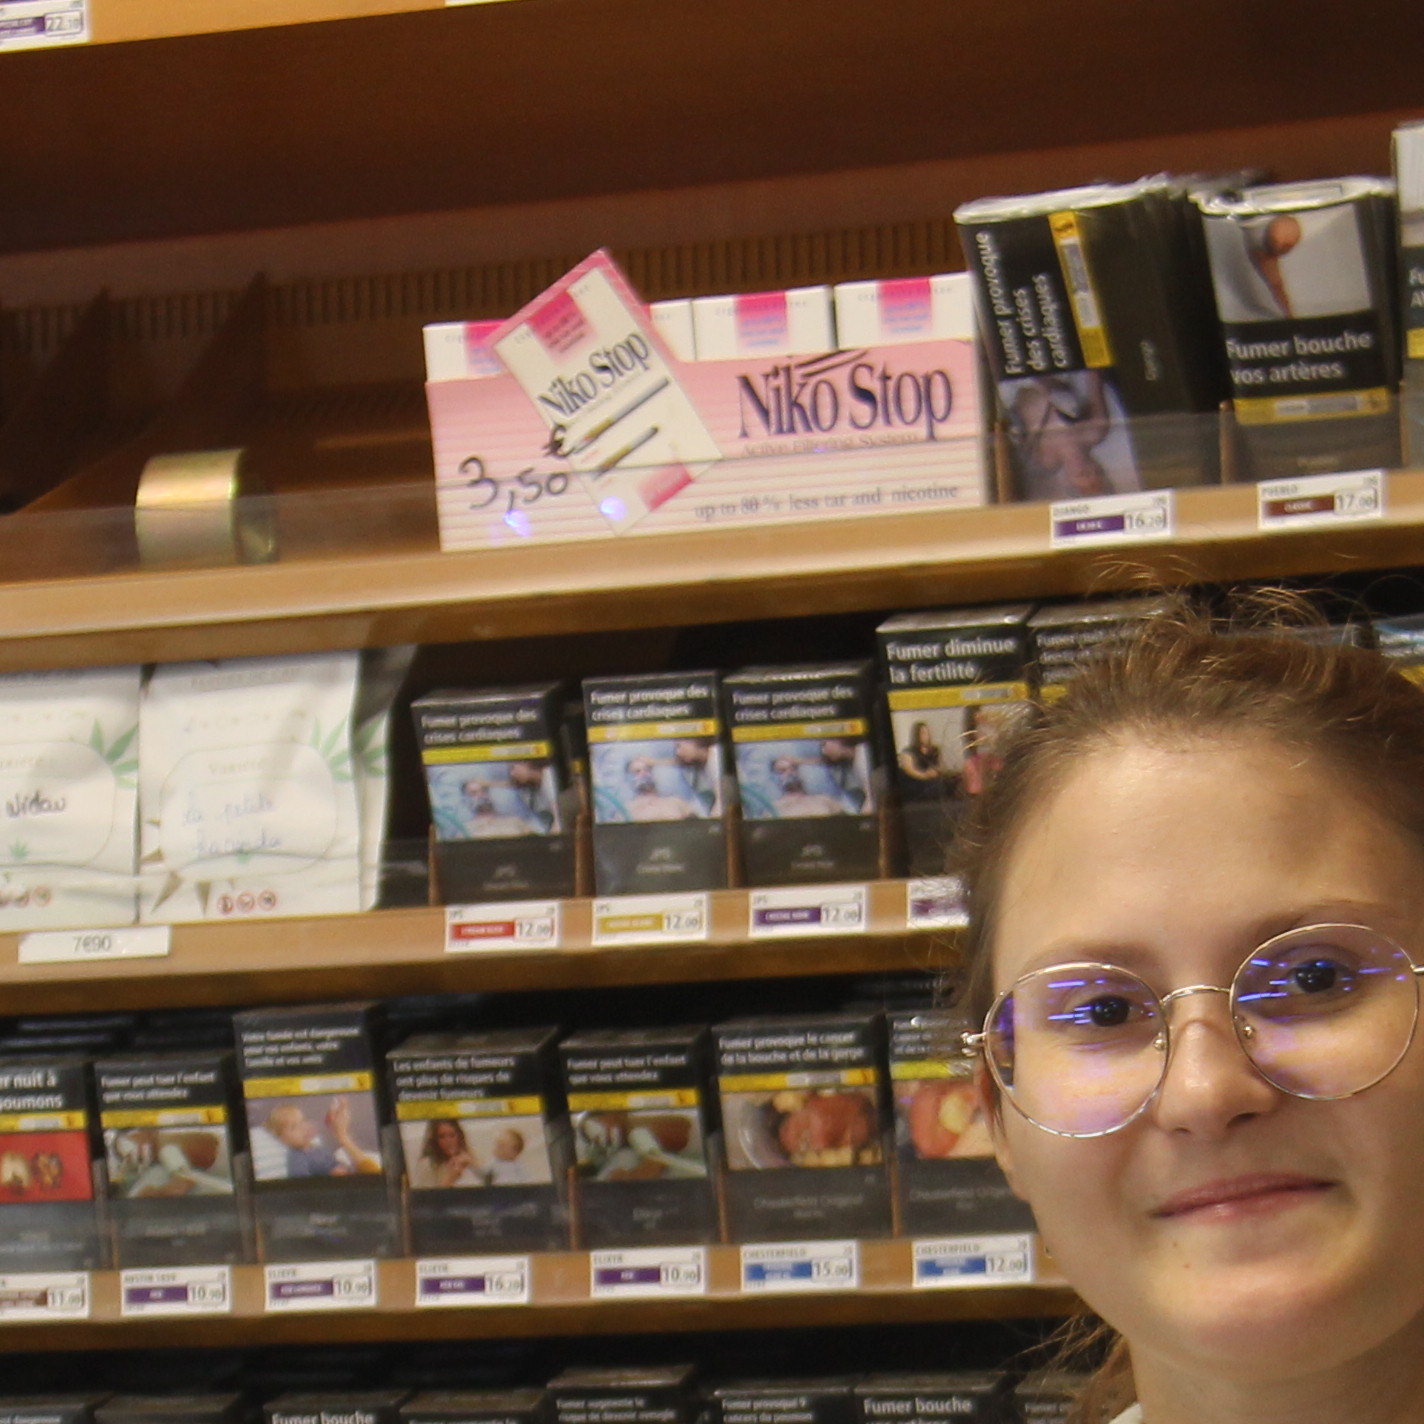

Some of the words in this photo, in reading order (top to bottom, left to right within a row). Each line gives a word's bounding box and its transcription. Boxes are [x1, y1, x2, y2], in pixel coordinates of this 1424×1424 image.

[1226, 337, 1290, 361] Fumer
[1293, 331, 1372, 356] bouche
[1230, 365, 1265, 386] vos
[1270, 359, 1344, 382] artères
[737, 362, 839, 439] Niko
[848, 362, 952, 440] Stop
[886, 642, 940, 660] Fumer
[945, 638, 1018, 657] diminue
[890, 664, 908, 683] la
[910, 661, 977, 682] fertilité
[72, 936, 112, 953] 7€90
[863, 1398, 910, 1415] Fumer
[914, 1397, 973, 1414] bouche
